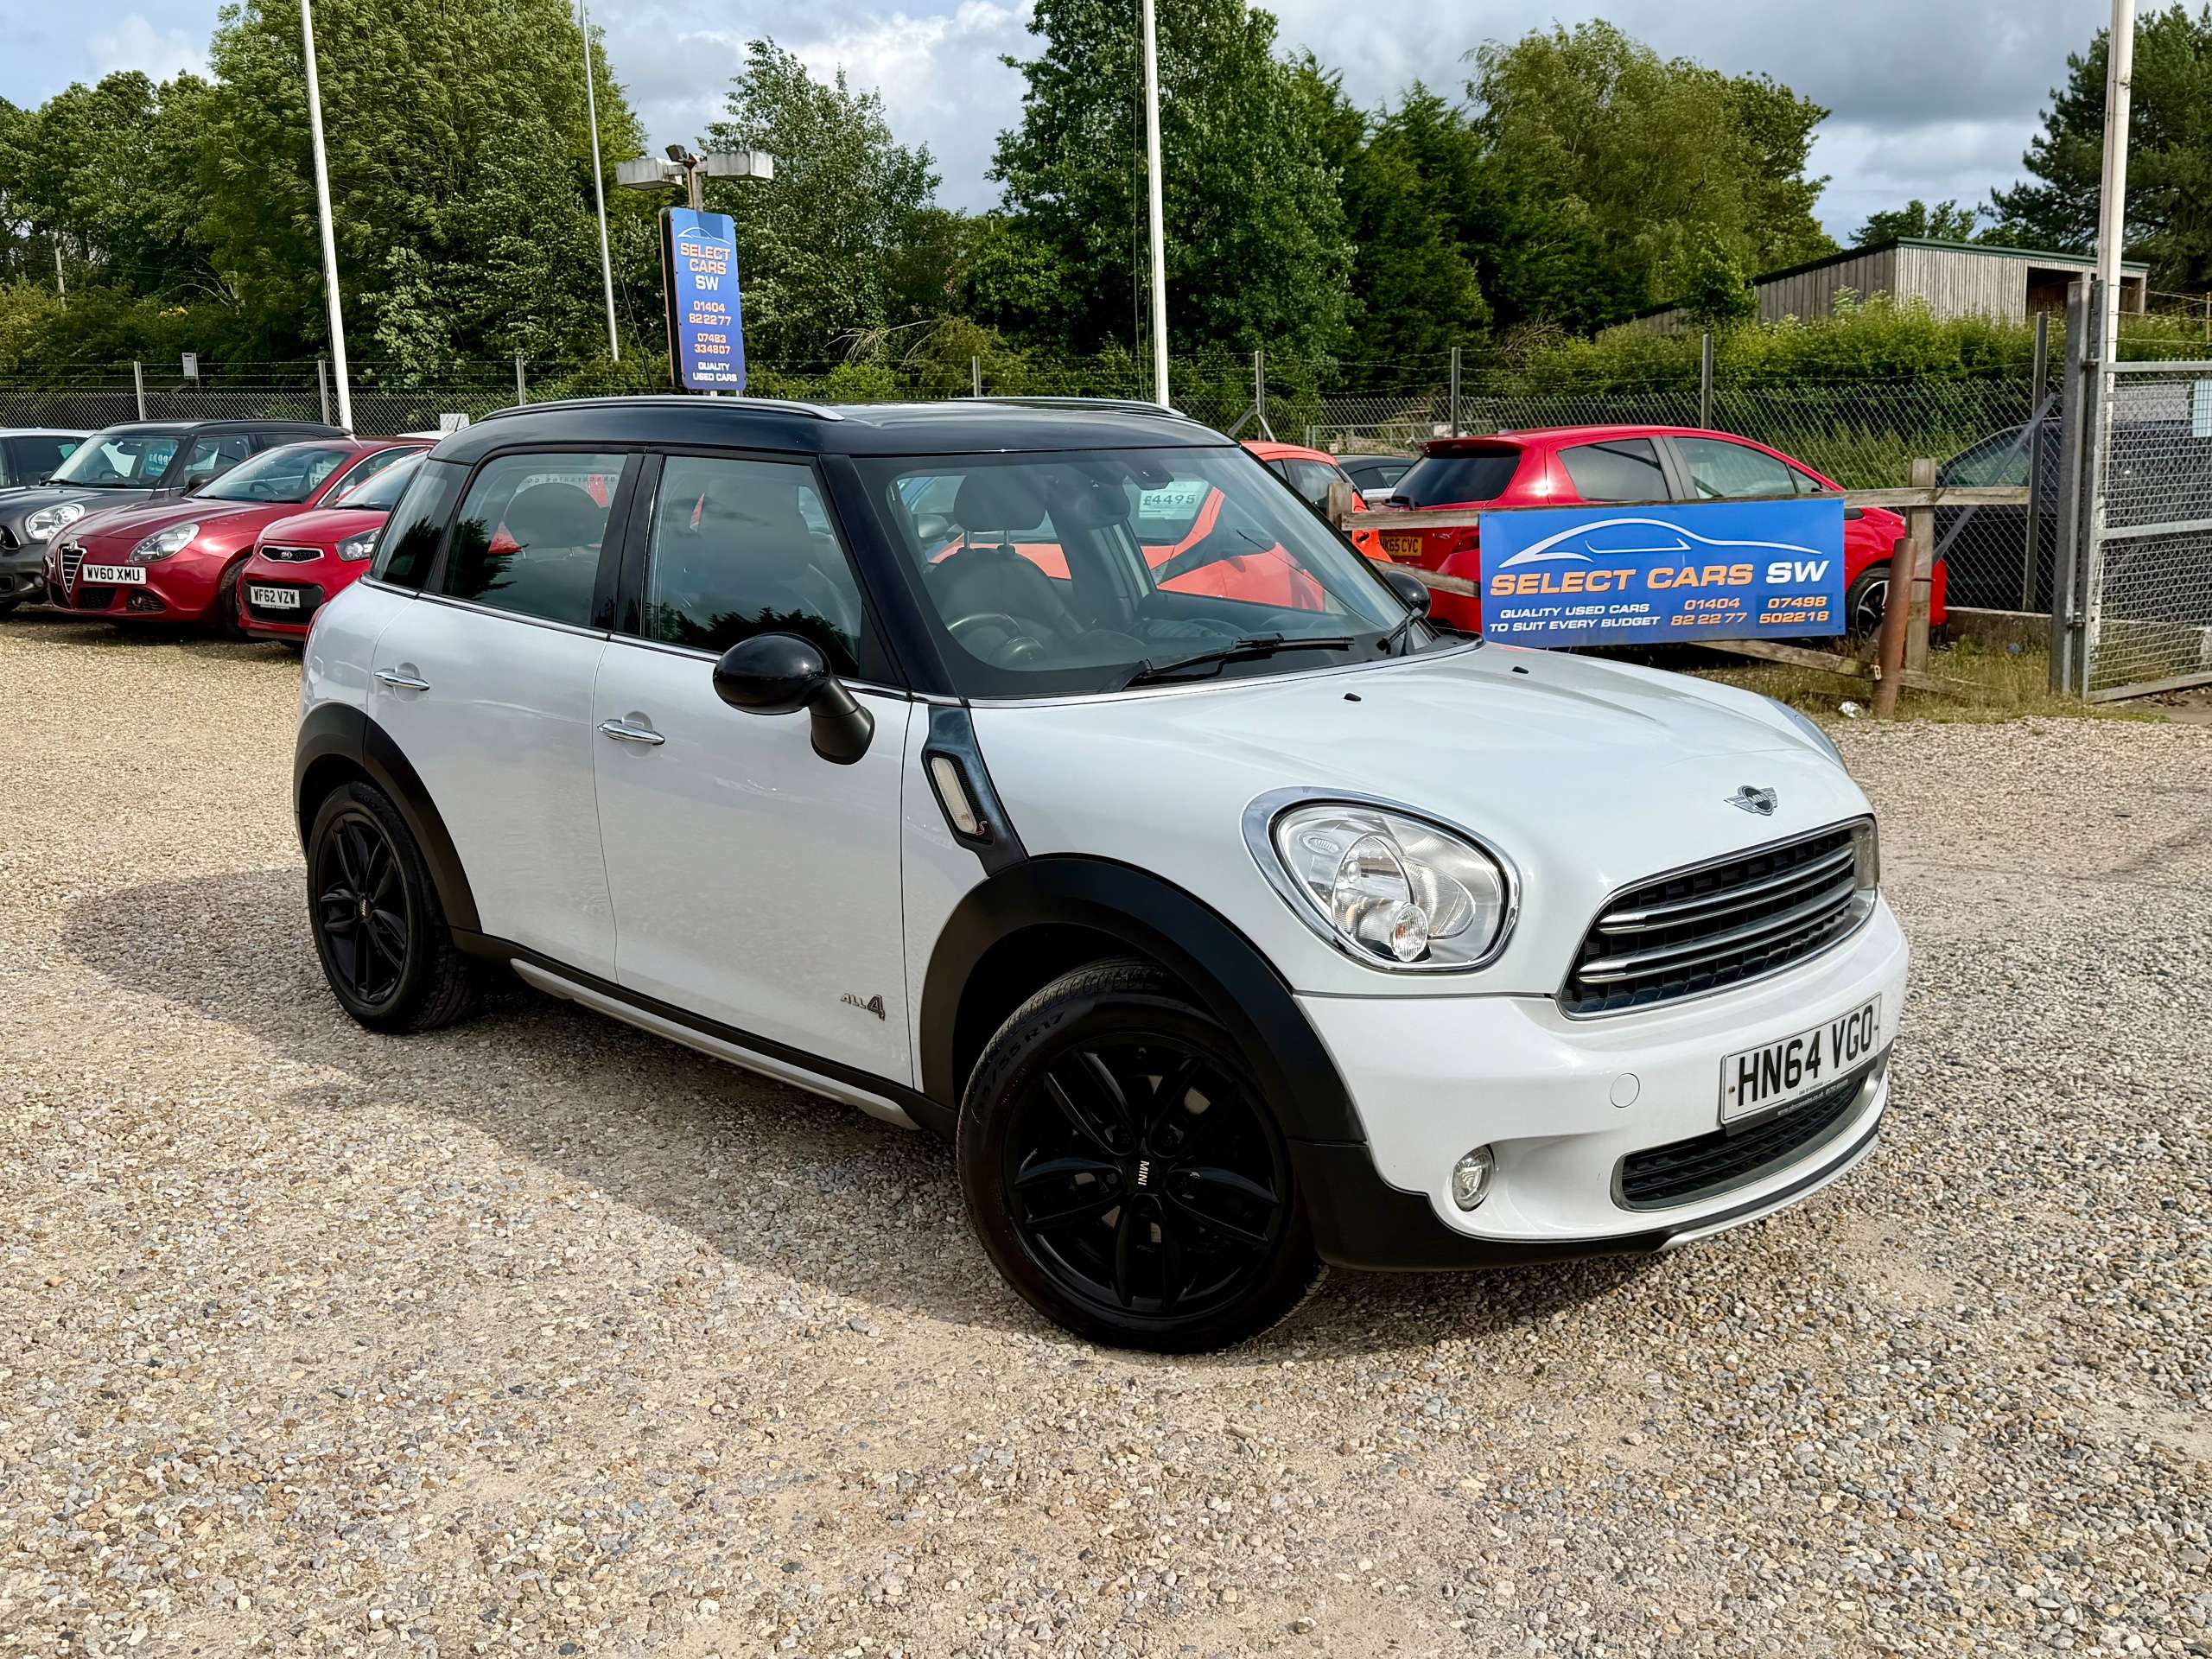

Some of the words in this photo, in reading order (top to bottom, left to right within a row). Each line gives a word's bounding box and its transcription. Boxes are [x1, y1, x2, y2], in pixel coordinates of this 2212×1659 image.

[680, 242, 731, 261] SELECT
[689, 258, 727, 275] CARS
[695, 275, 719, 291] SW
[693, 301, 726, 313] 01404
[697, 361, 730, 371] QUALITY
[692, 372, 714, 381] USED
[715, 373, 737, 382] CARS
[1142, 494, 1196, 505] £4495
[86, 566, 114, 580] WV60
[117, 569, 140, 582] XMU
[1490, 569, 1637, 596] SELECT
[1647, 563, 1754, 589] CARS
[1766, 560, 1830, 584] SW
[253, 588, 276, 603] WF62
[276, 590, 296, 605] VZW
[1684, 597, 1741, 611] 01404
[1767, 596, 1827, 609] 07498
[1500, 607, 1562, 619] QUALITY
[1565, 606, 1605, 616] USED
[1609, 603, 1650, 614] CARS
[1758, 610, 1830, 624] 502218
[1490, 623, 1509, 632] TO
[1512, 621, 1547, 632] SUIT
[1548, 619, 1599, 630] EVERY
[1601, 616, 1661, 628] BUDGET
[1738, 1030, 1821, 1107] HN64
[1832, 1004, 1873, 1069] VGO
[1137, 1160, 1149, 1185] MINI
